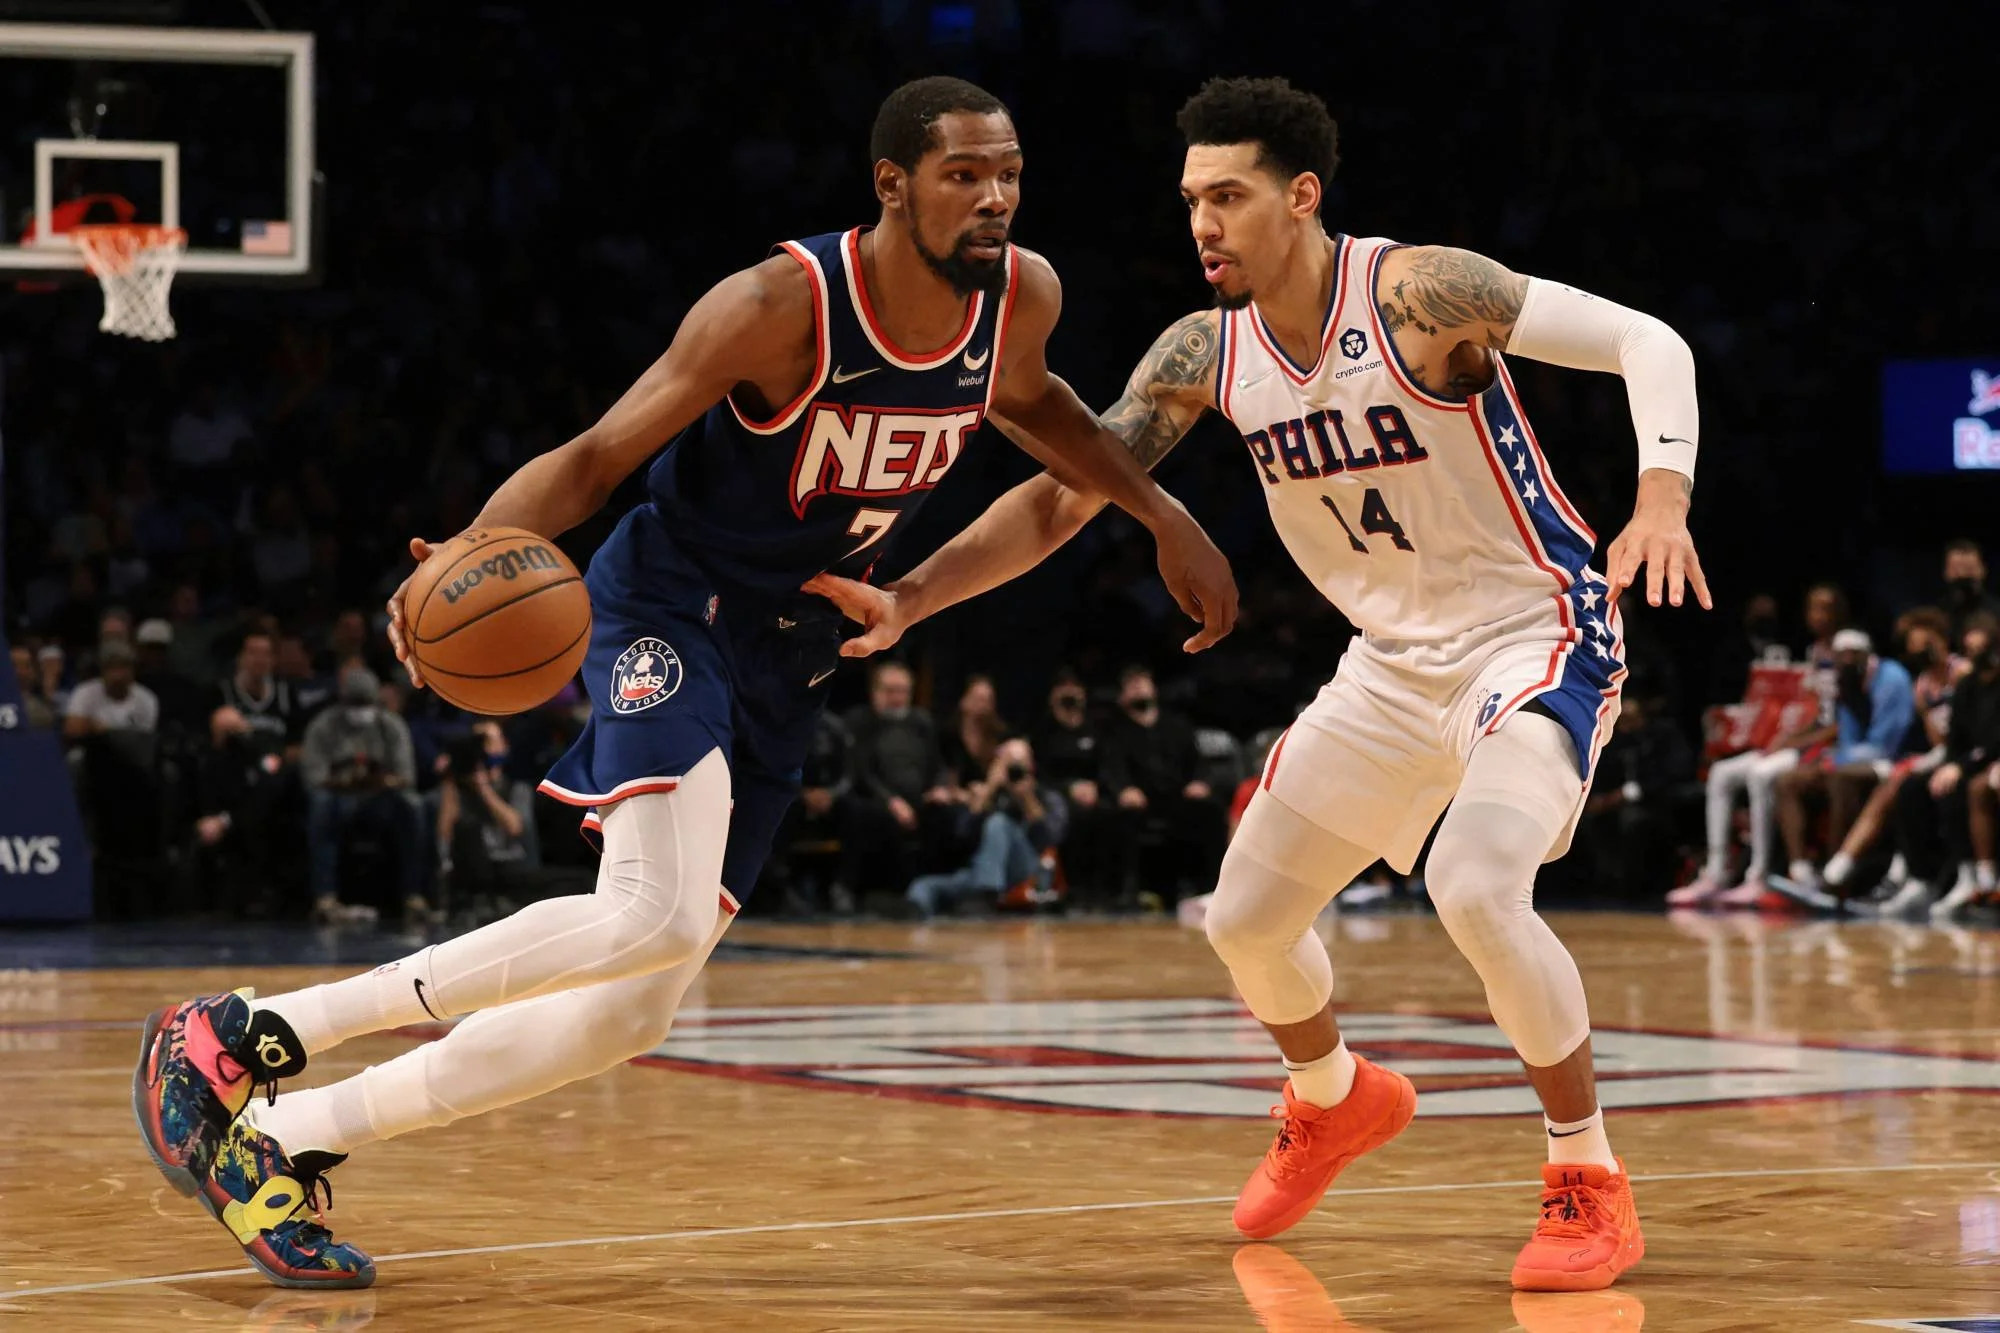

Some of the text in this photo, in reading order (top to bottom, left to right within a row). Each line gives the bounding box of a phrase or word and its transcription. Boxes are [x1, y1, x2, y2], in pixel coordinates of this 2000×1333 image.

[958, 375, 985, 387] Webull
[1335, 360, 1383, 378] crypto.com
[793, 404, 982, 511] NETS
[1245, 404, 1429, 485] PHILA
[847, 507, 902, 560] 7
[1320, 488, 1416, 554] 14
[440, 545, 562, 605] Wilson
[616, 641, 677, 672] BROOKLYN
[620, 672, 664, 695] Nets
[635, 687, 669, 708] YORK
[614, 694, 630, 710] NEW
